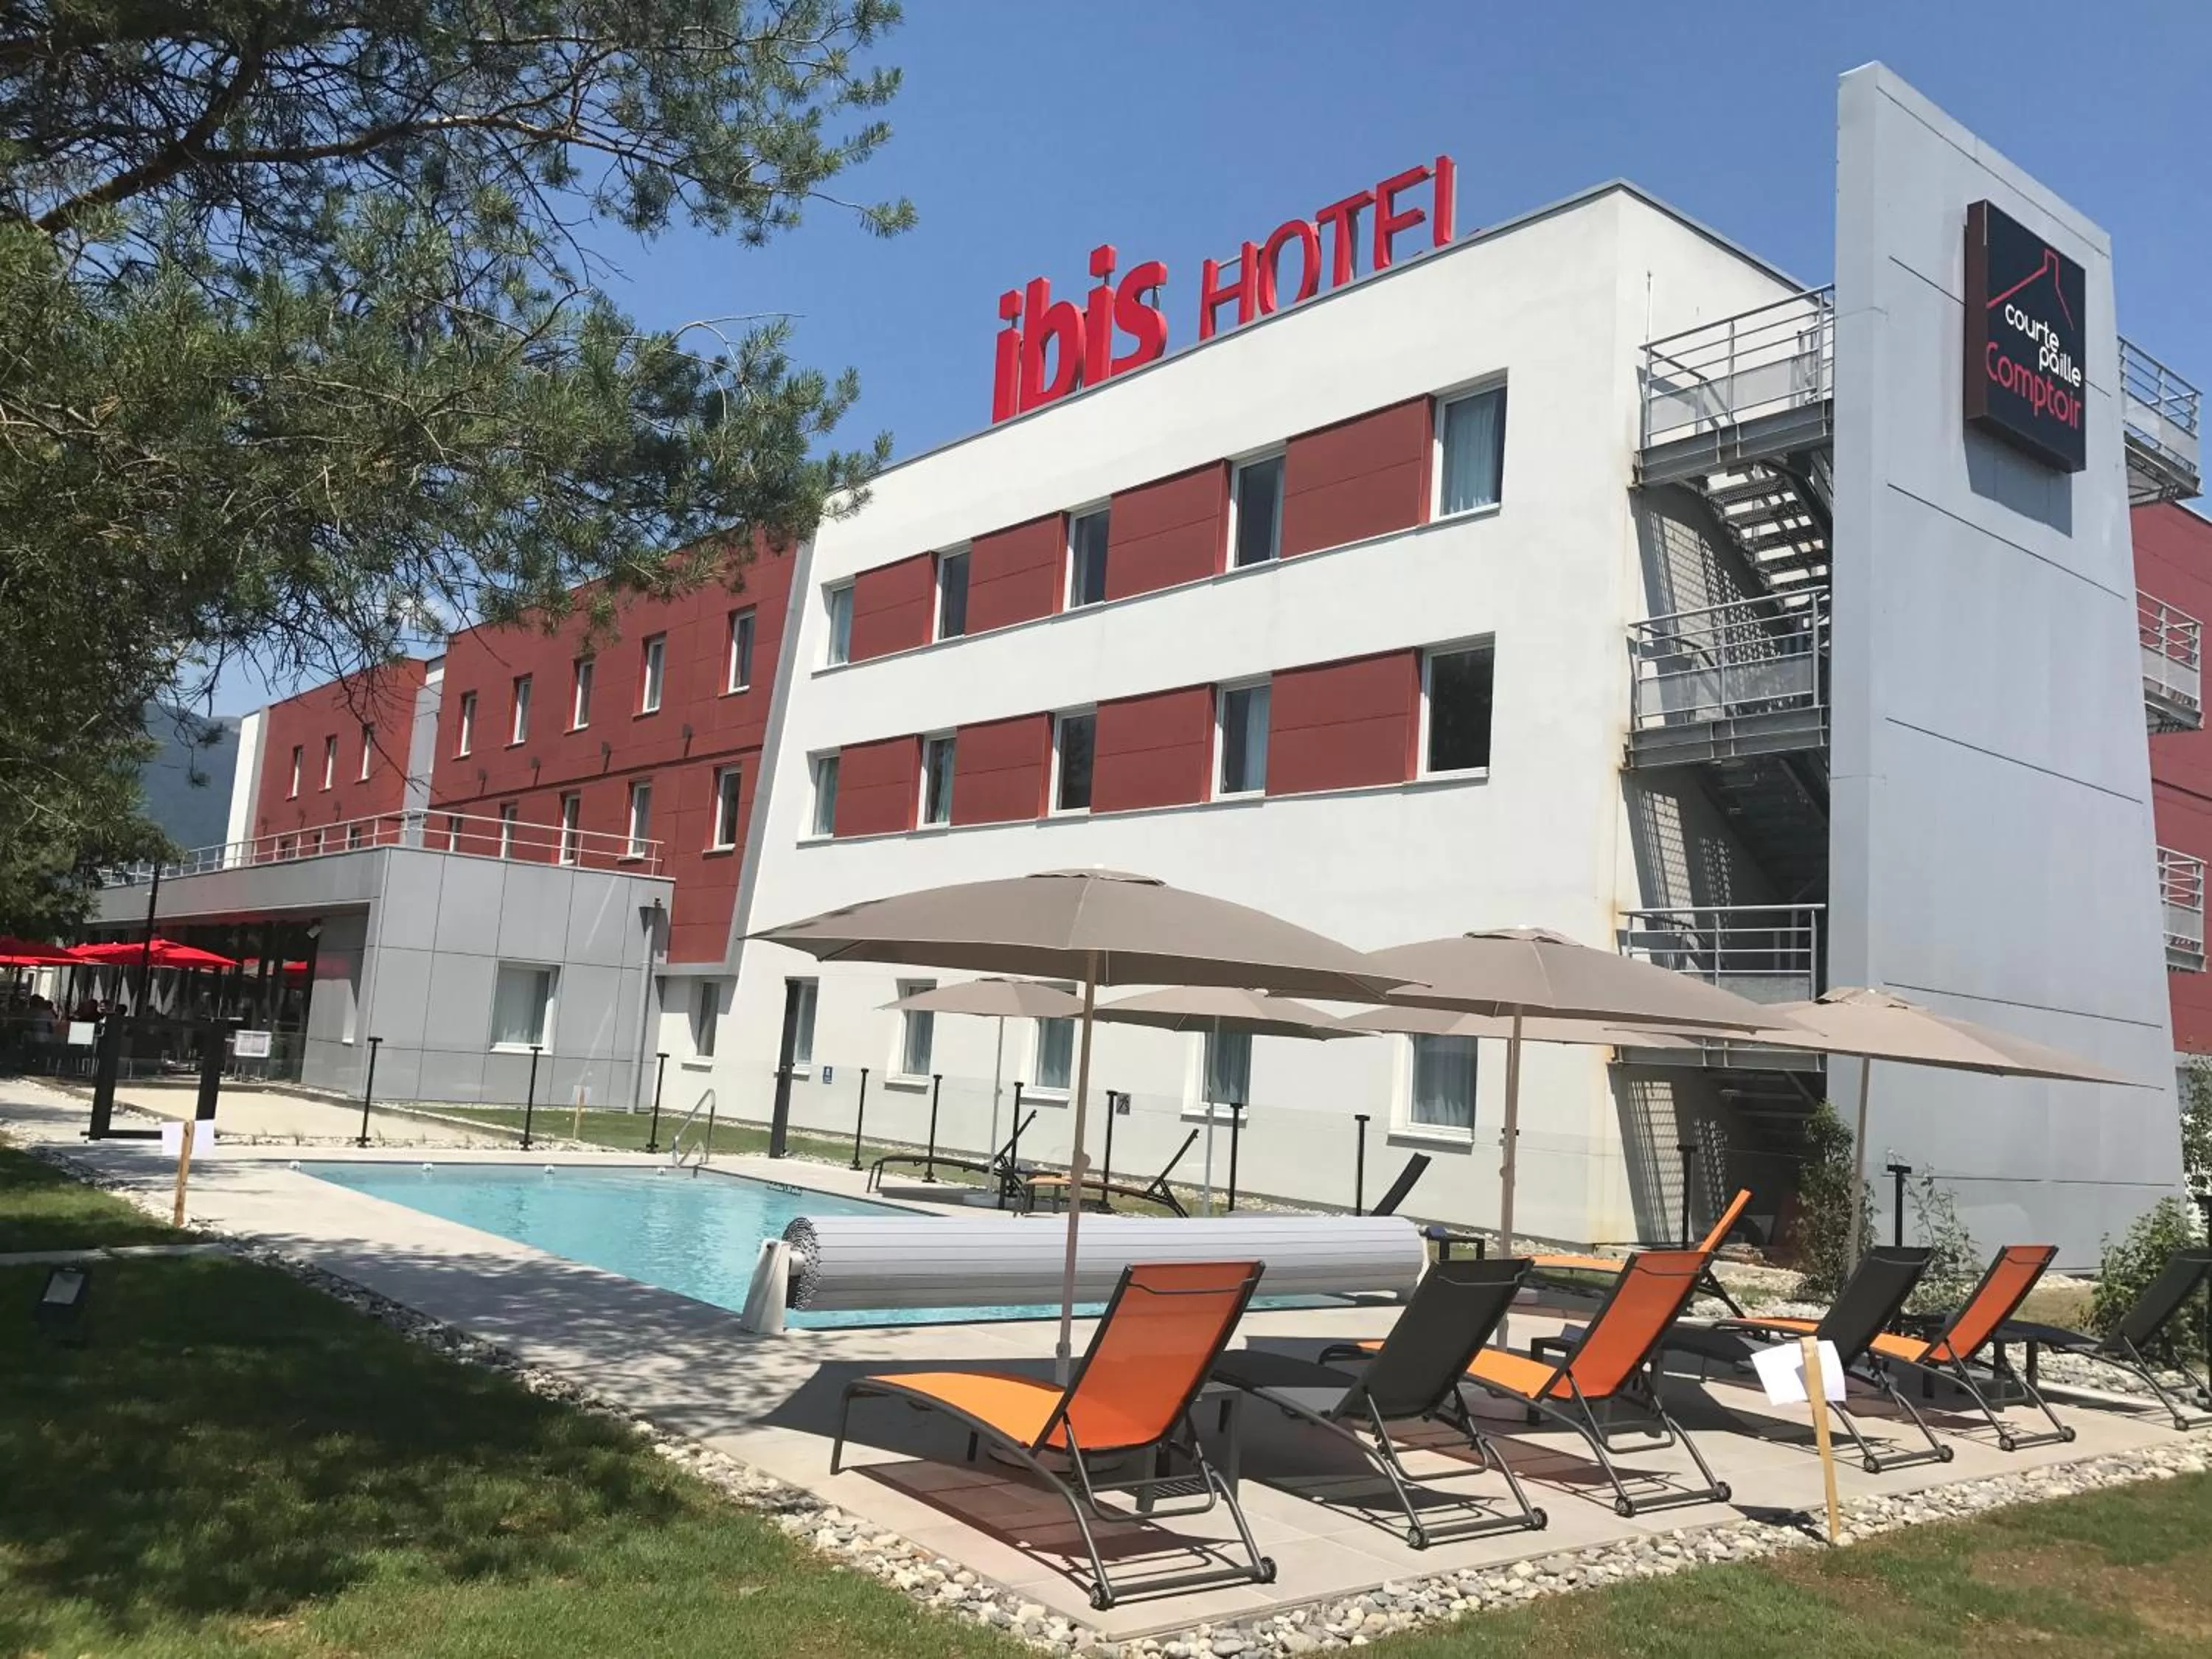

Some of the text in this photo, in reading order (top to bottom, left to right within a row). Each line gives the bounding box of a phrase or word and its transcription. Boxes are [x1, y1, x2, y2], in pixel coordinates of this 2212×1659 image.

[992, 243, 1168, 425] ibis
[2004, 303, 2059, 352] courte
[1986, 341, 2082, 429] Comptoir
[2039, 345, 2082, 388] paille
